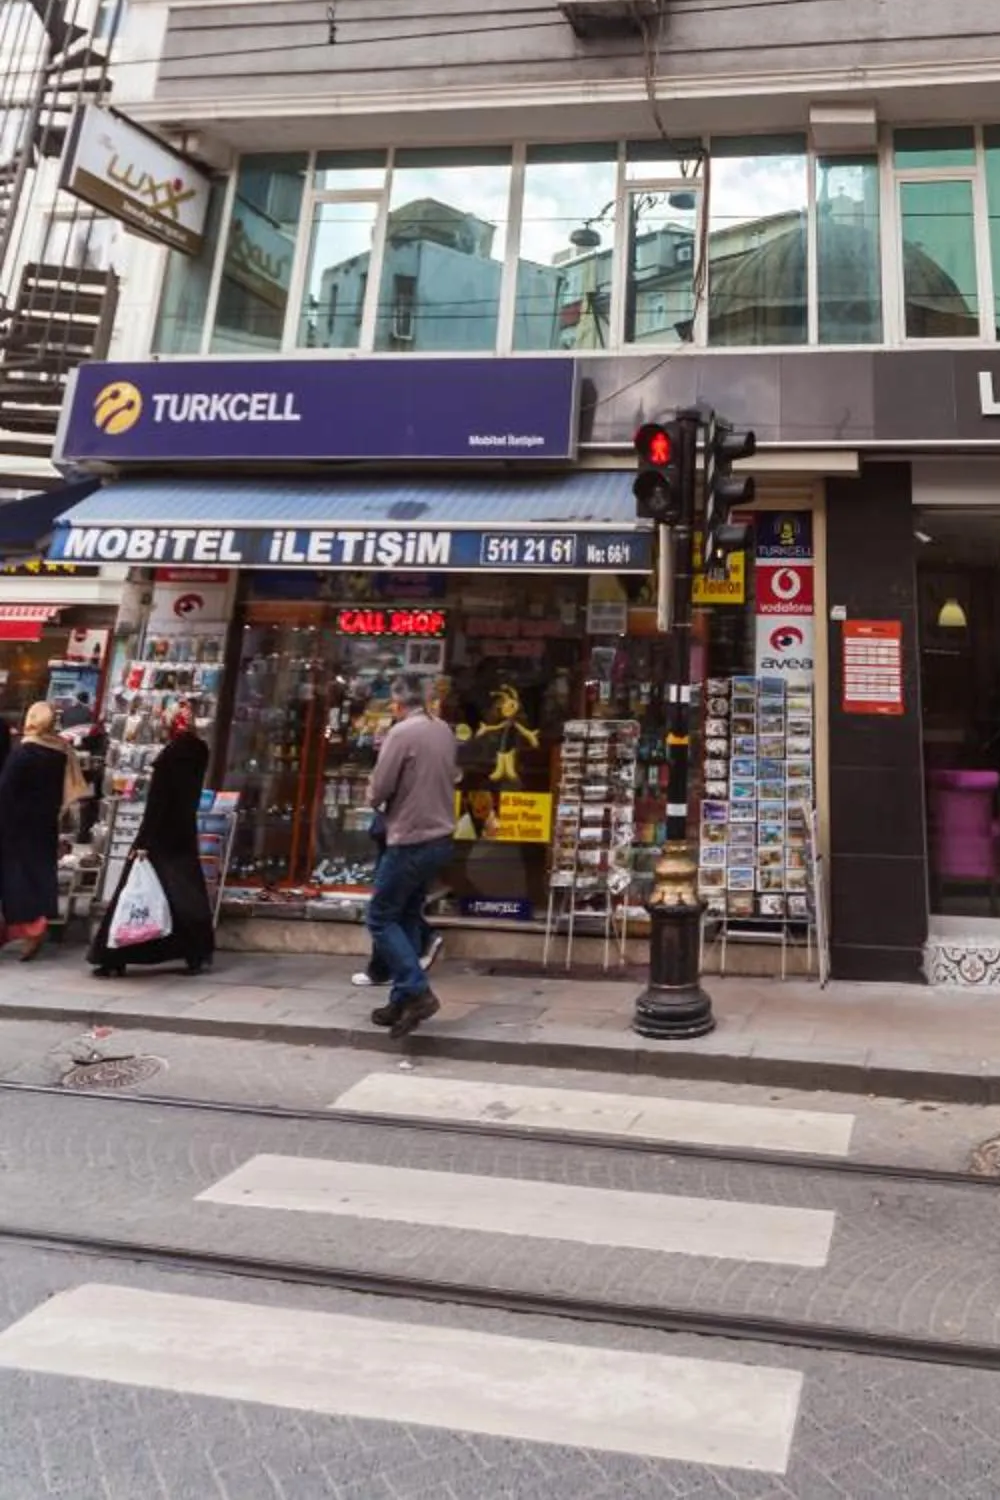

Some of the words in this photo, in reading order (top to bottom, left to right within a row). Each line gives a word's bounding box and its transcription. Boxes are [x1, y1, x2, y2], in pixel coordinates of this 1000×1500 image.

[152, 392, 301, 422] TURKCELL
[487, 537, 517, 562] 511
[523, 538, 545, 562] 21
[551, 539, 573, 562] 61
[759, 546, 812, 557] TURKCELL
[759, 602, 813, 613] vodafone
[339, 611, 385, 632] CALL
[391, 611, 443, 632] SHOP
[761, 657, 814, 670] avea
